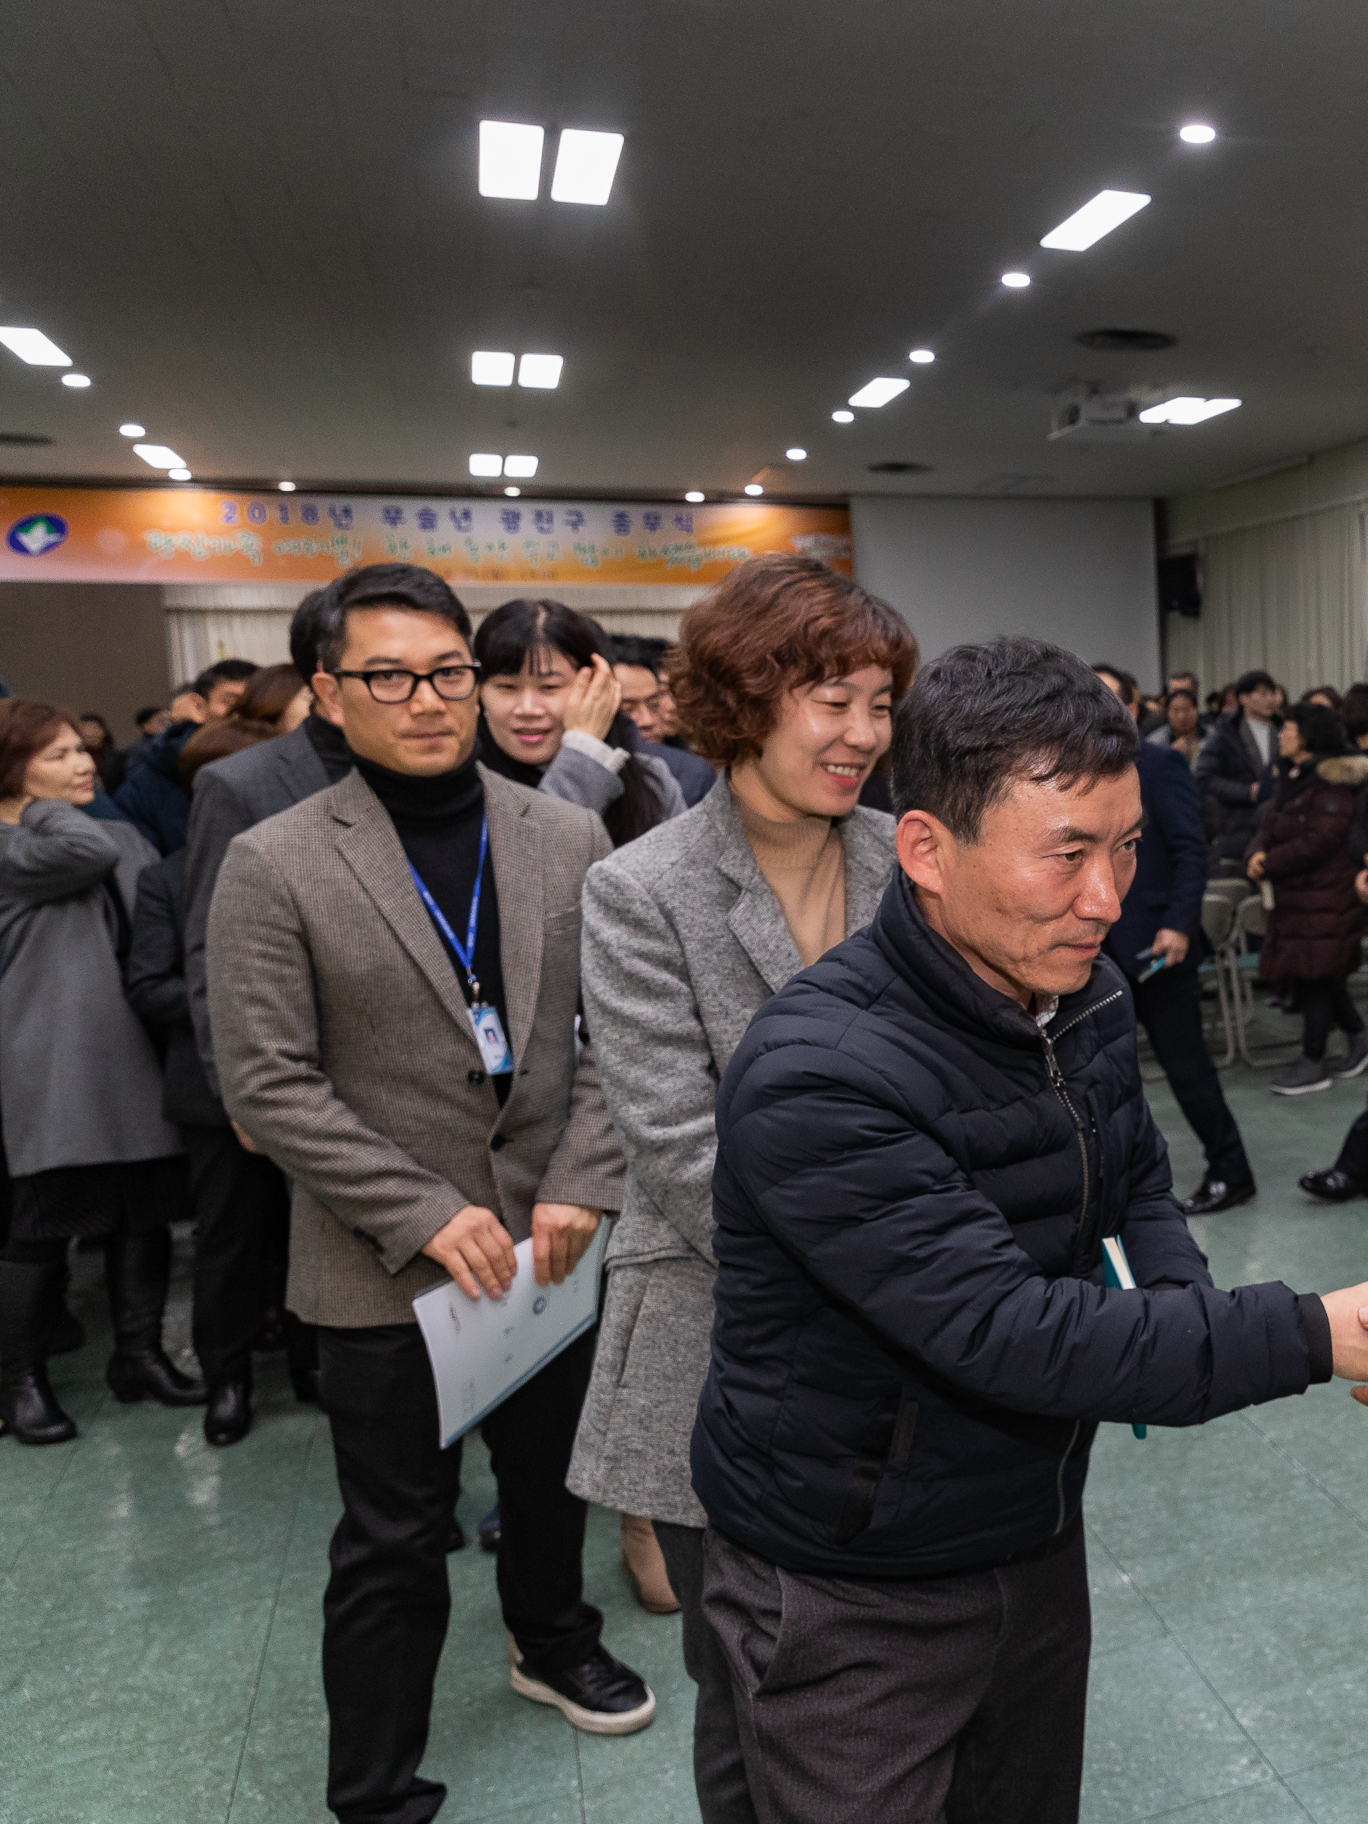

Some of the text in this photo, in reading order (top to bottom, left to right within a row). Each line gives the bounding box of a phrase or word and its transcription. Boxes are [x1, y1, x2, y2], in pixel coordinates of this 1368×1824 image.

[220, 500, 354, 530] 2018년
[382, 504, 474, 533] 무술년
[500, 507, 586, 535] 광진구
